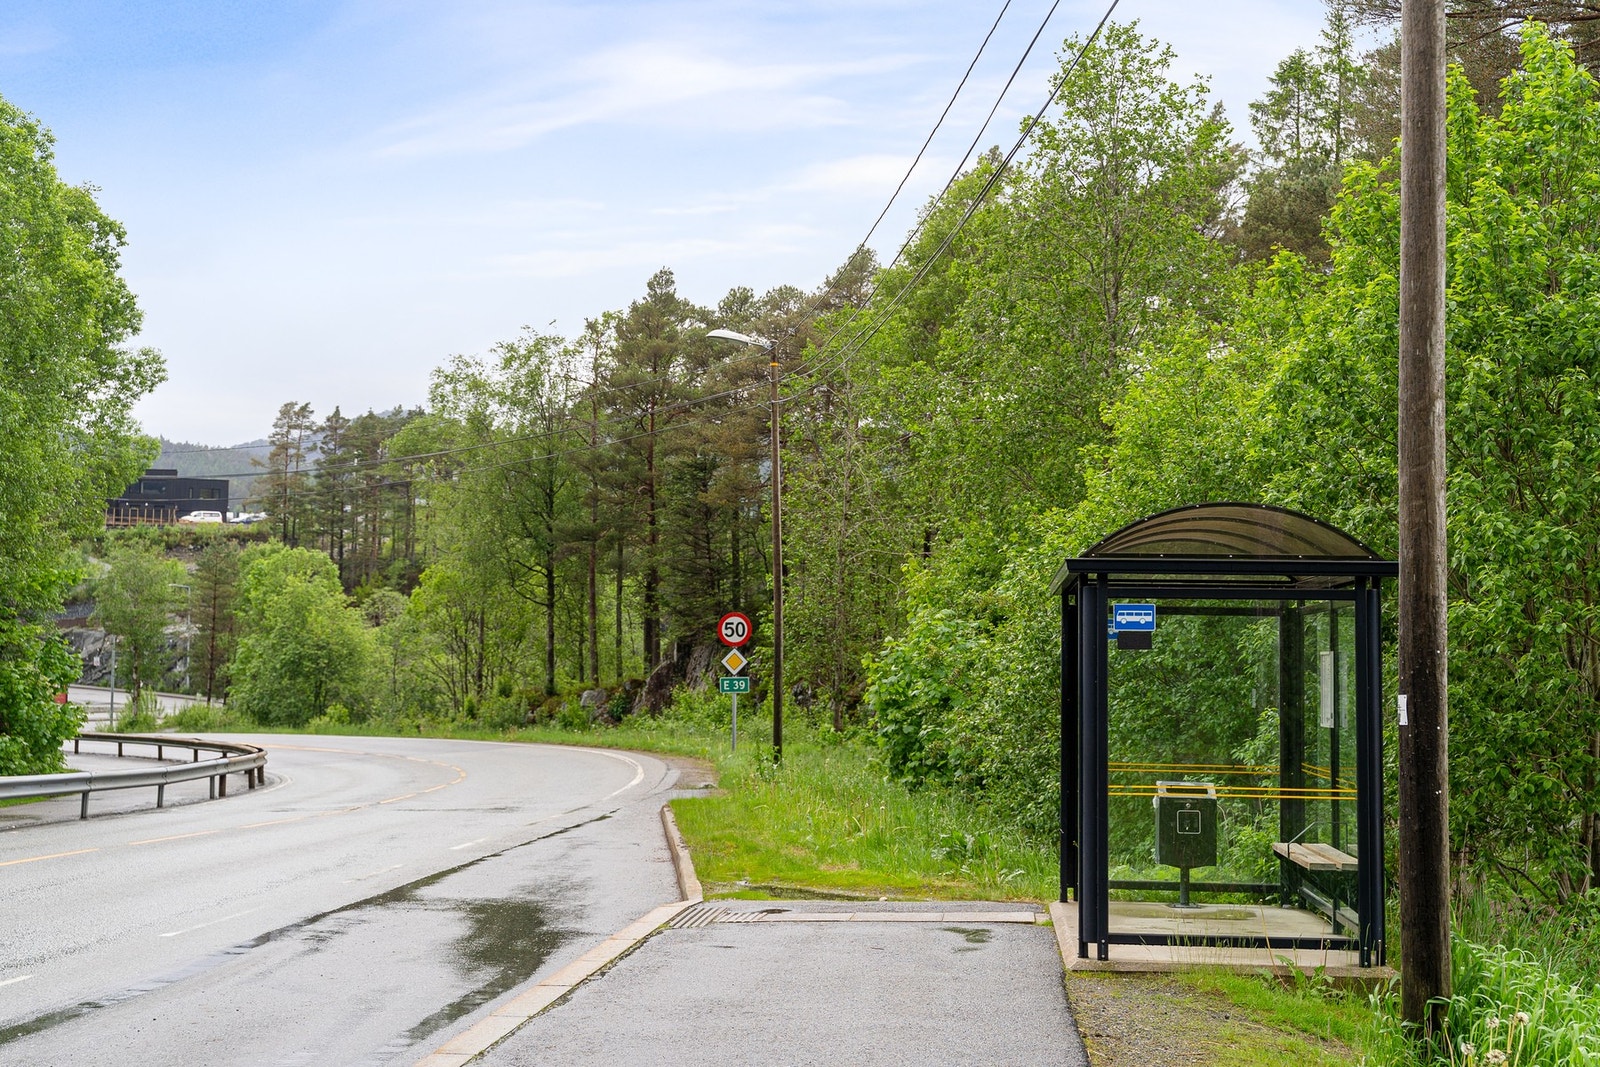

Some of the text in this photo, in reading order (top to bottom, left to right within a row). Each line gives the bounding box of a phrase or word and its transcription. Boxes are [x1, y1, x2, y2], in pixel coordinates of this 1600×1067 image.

[724, 622, 745, 637] 50
[724, 681, 746, 690] E 39
